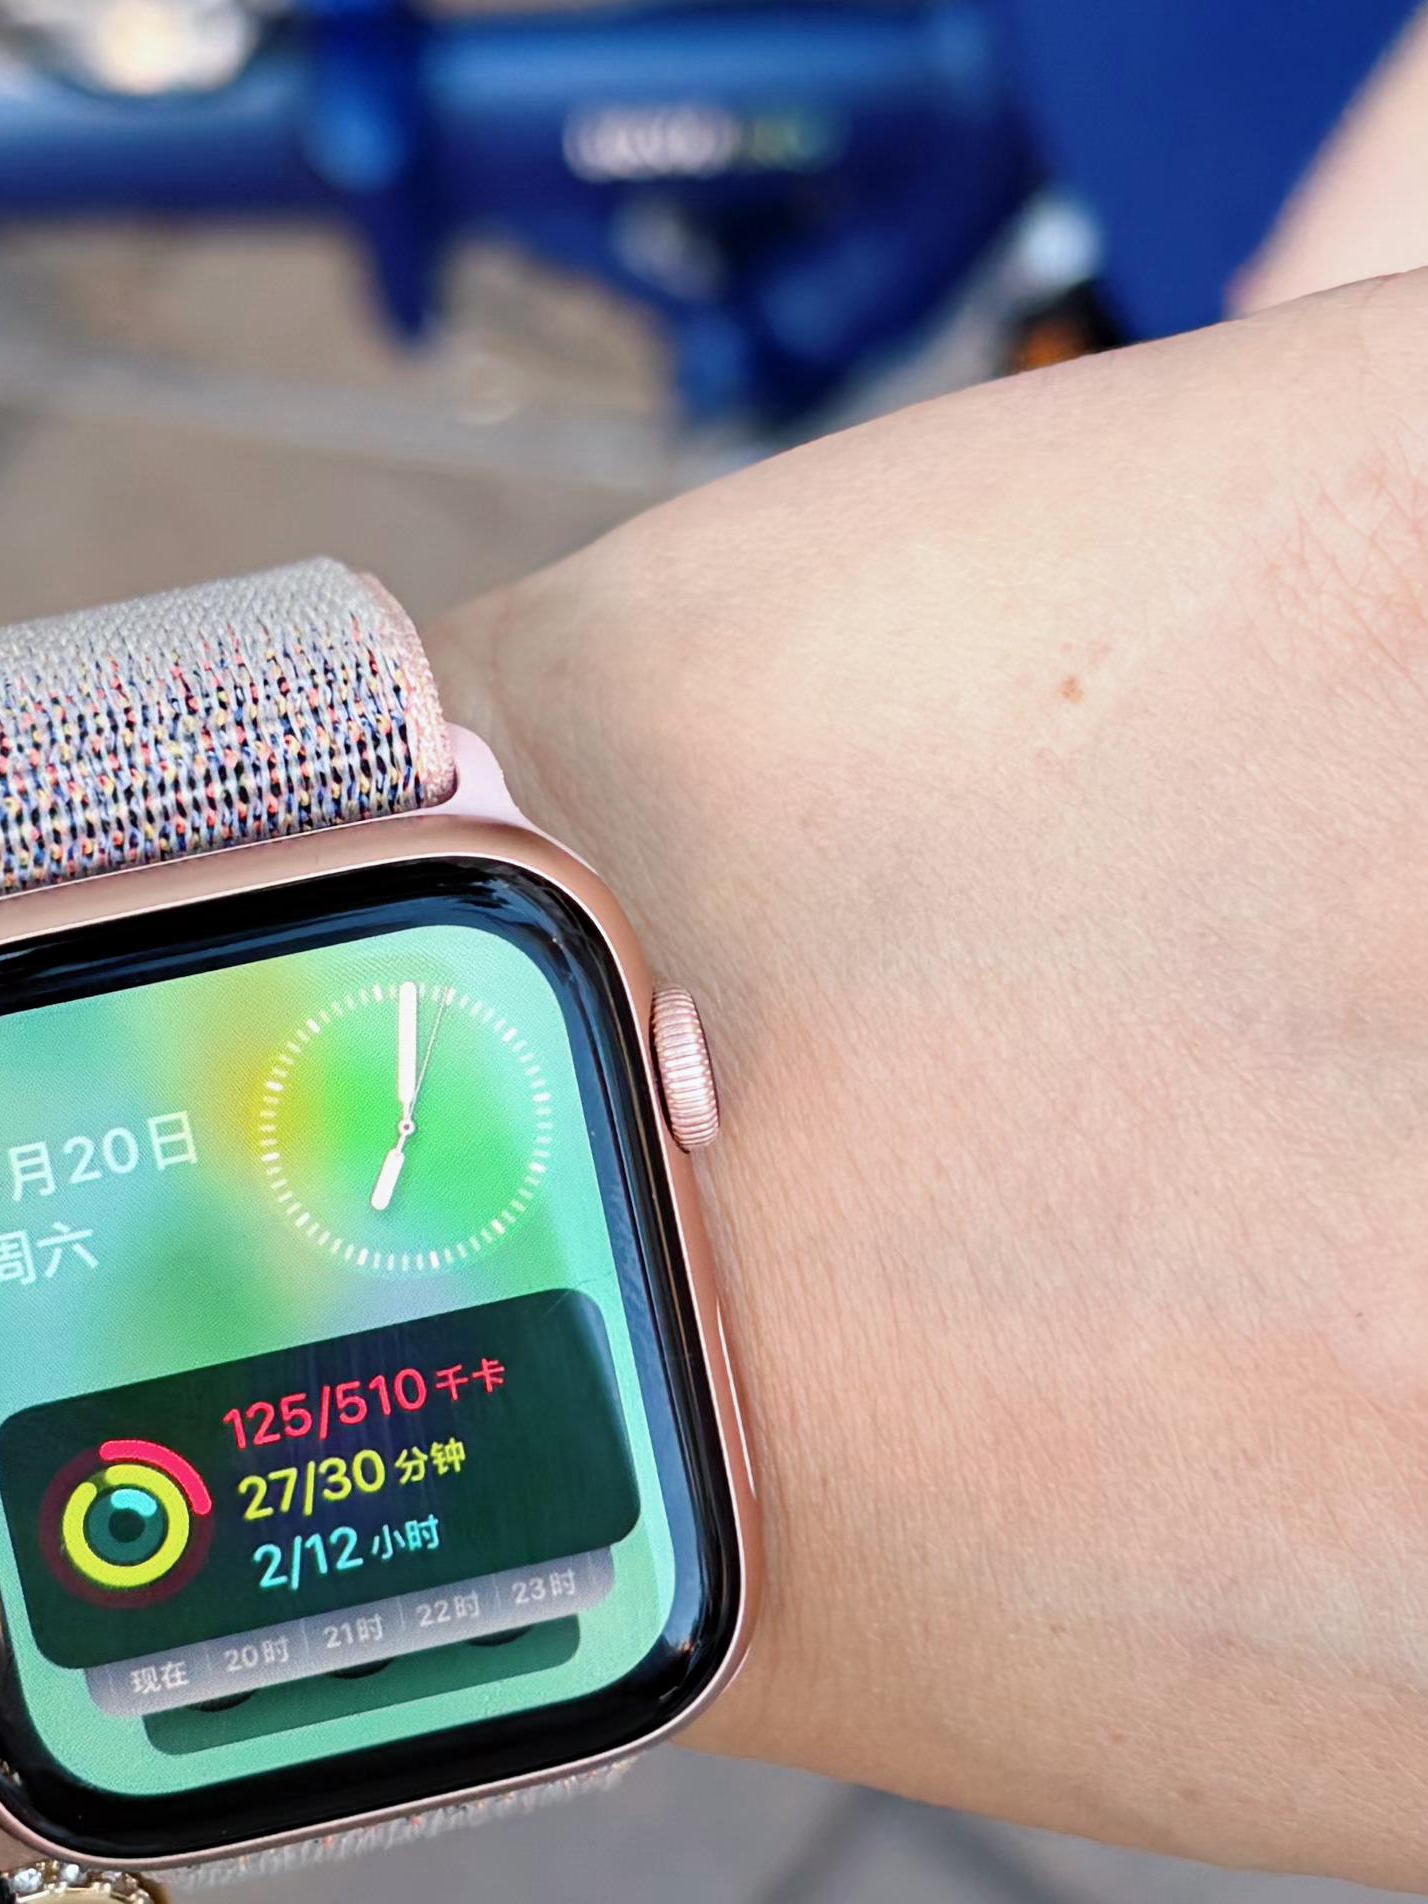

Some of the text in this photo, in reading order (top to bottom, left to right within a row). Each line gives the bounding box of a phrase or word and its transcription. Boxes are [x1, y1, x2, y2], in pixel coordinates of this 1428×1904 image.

[130, 1567, 576, 1694] 现在 20时 21时 22时 23时
